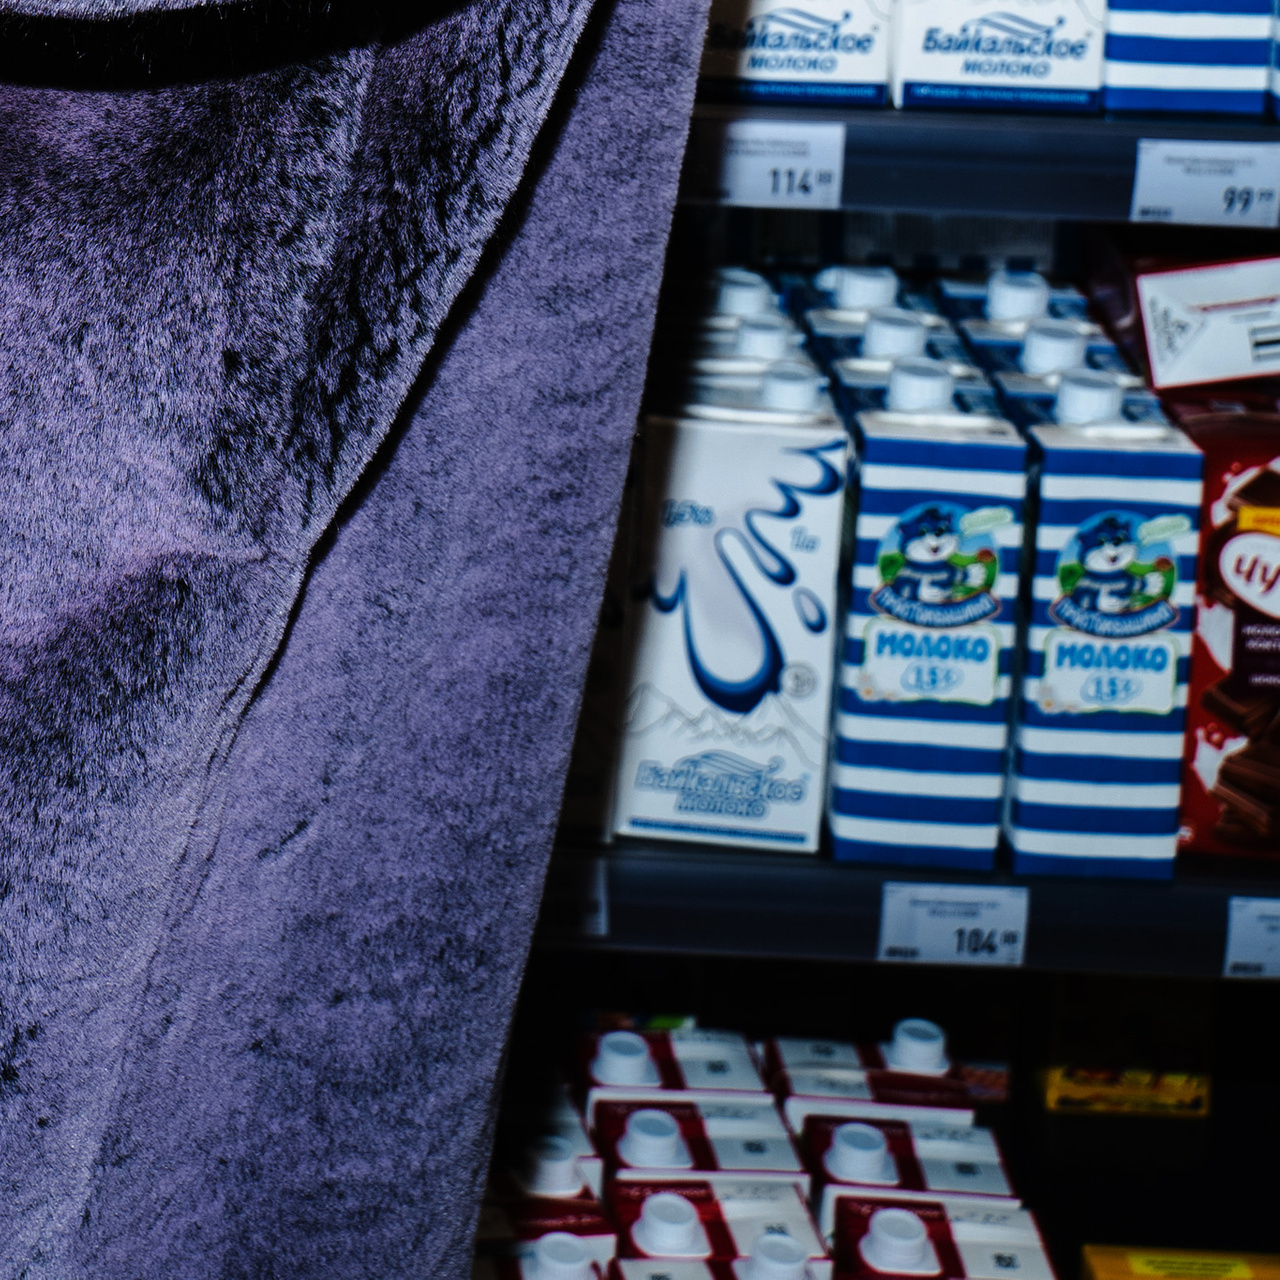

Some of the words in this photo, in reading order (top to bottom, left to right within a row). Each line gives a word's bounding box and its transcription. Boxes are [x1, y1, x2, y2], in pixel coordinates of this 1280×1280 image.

[922, 26, 1089, 60] Байкальское
[746, 53, 838, 74] молоко
[961, 57, 1051, 78] молоко
[769, 168, 812, 196] 114
[1224, 187, 1254, 212] 99
[876, 631, 989, 663] МОЛОКО
[1055, 643, 1169, 673] МОЛОКО
[954, 926, 998, 955] 104
